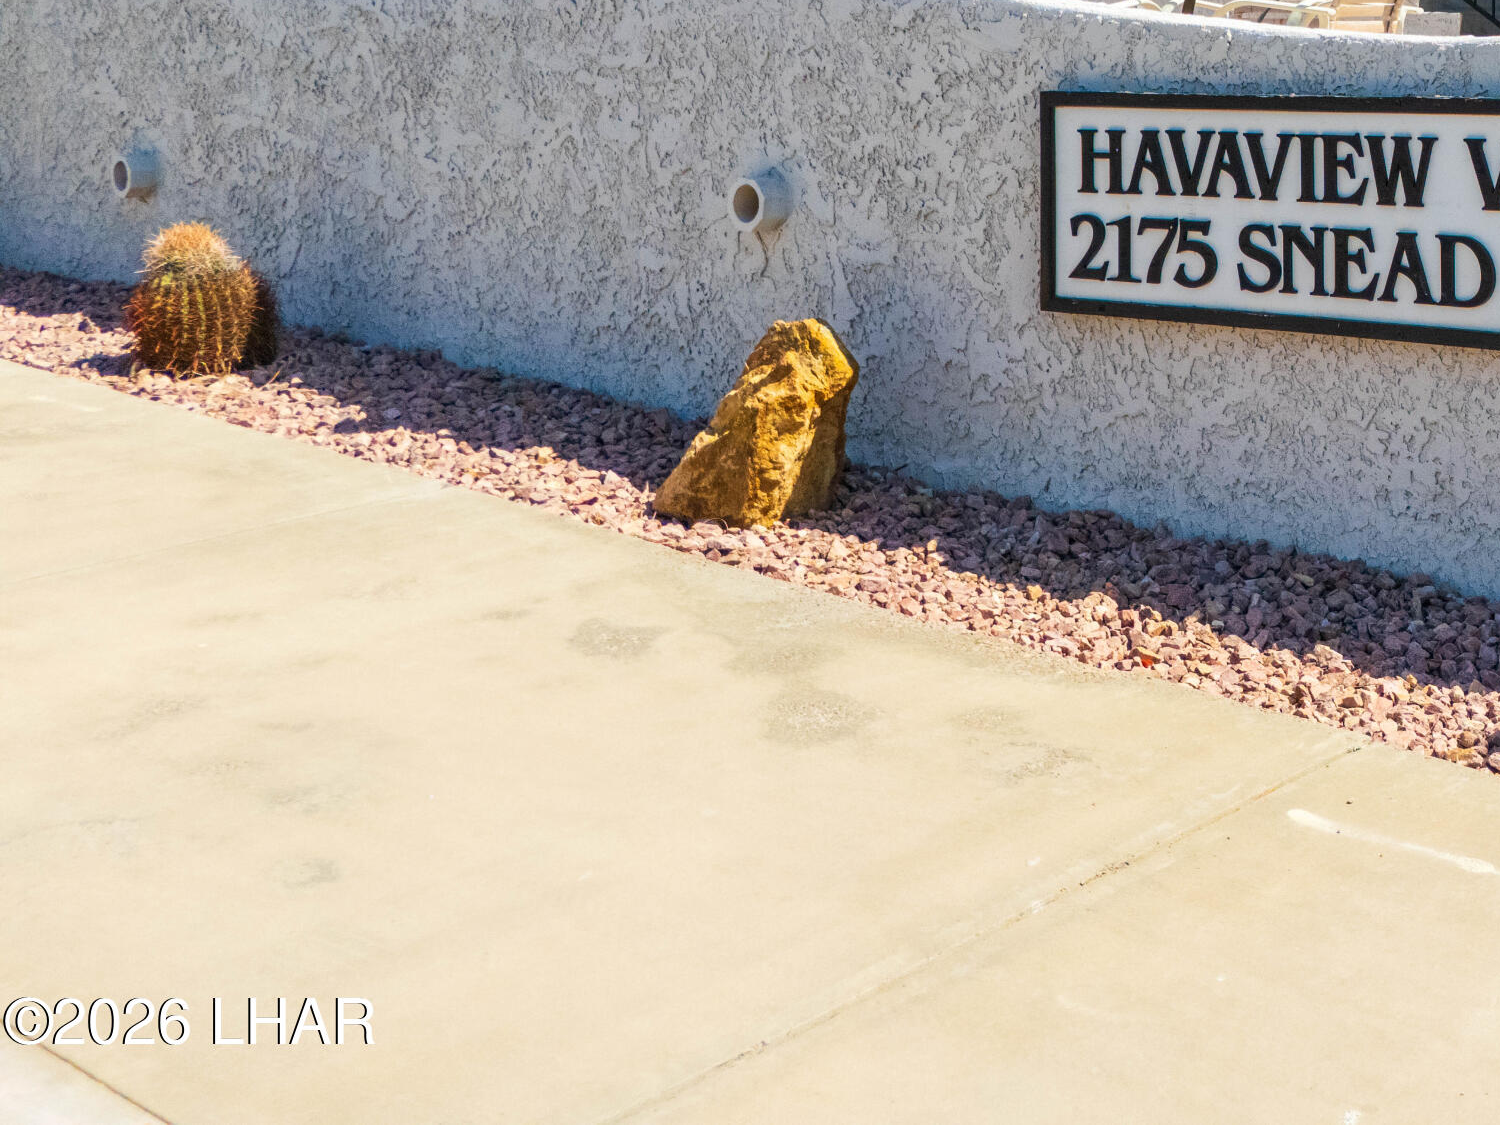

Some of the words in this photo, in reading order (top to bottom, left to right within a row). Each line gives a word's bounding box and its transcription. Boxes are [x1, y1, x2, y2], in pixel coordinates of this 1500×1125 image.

[1076, 128, 1440, 207] HAVAVIEW
[1068, 213, 1219, 289] 2175
[1236, 223, 1497, 309] SNEAD
